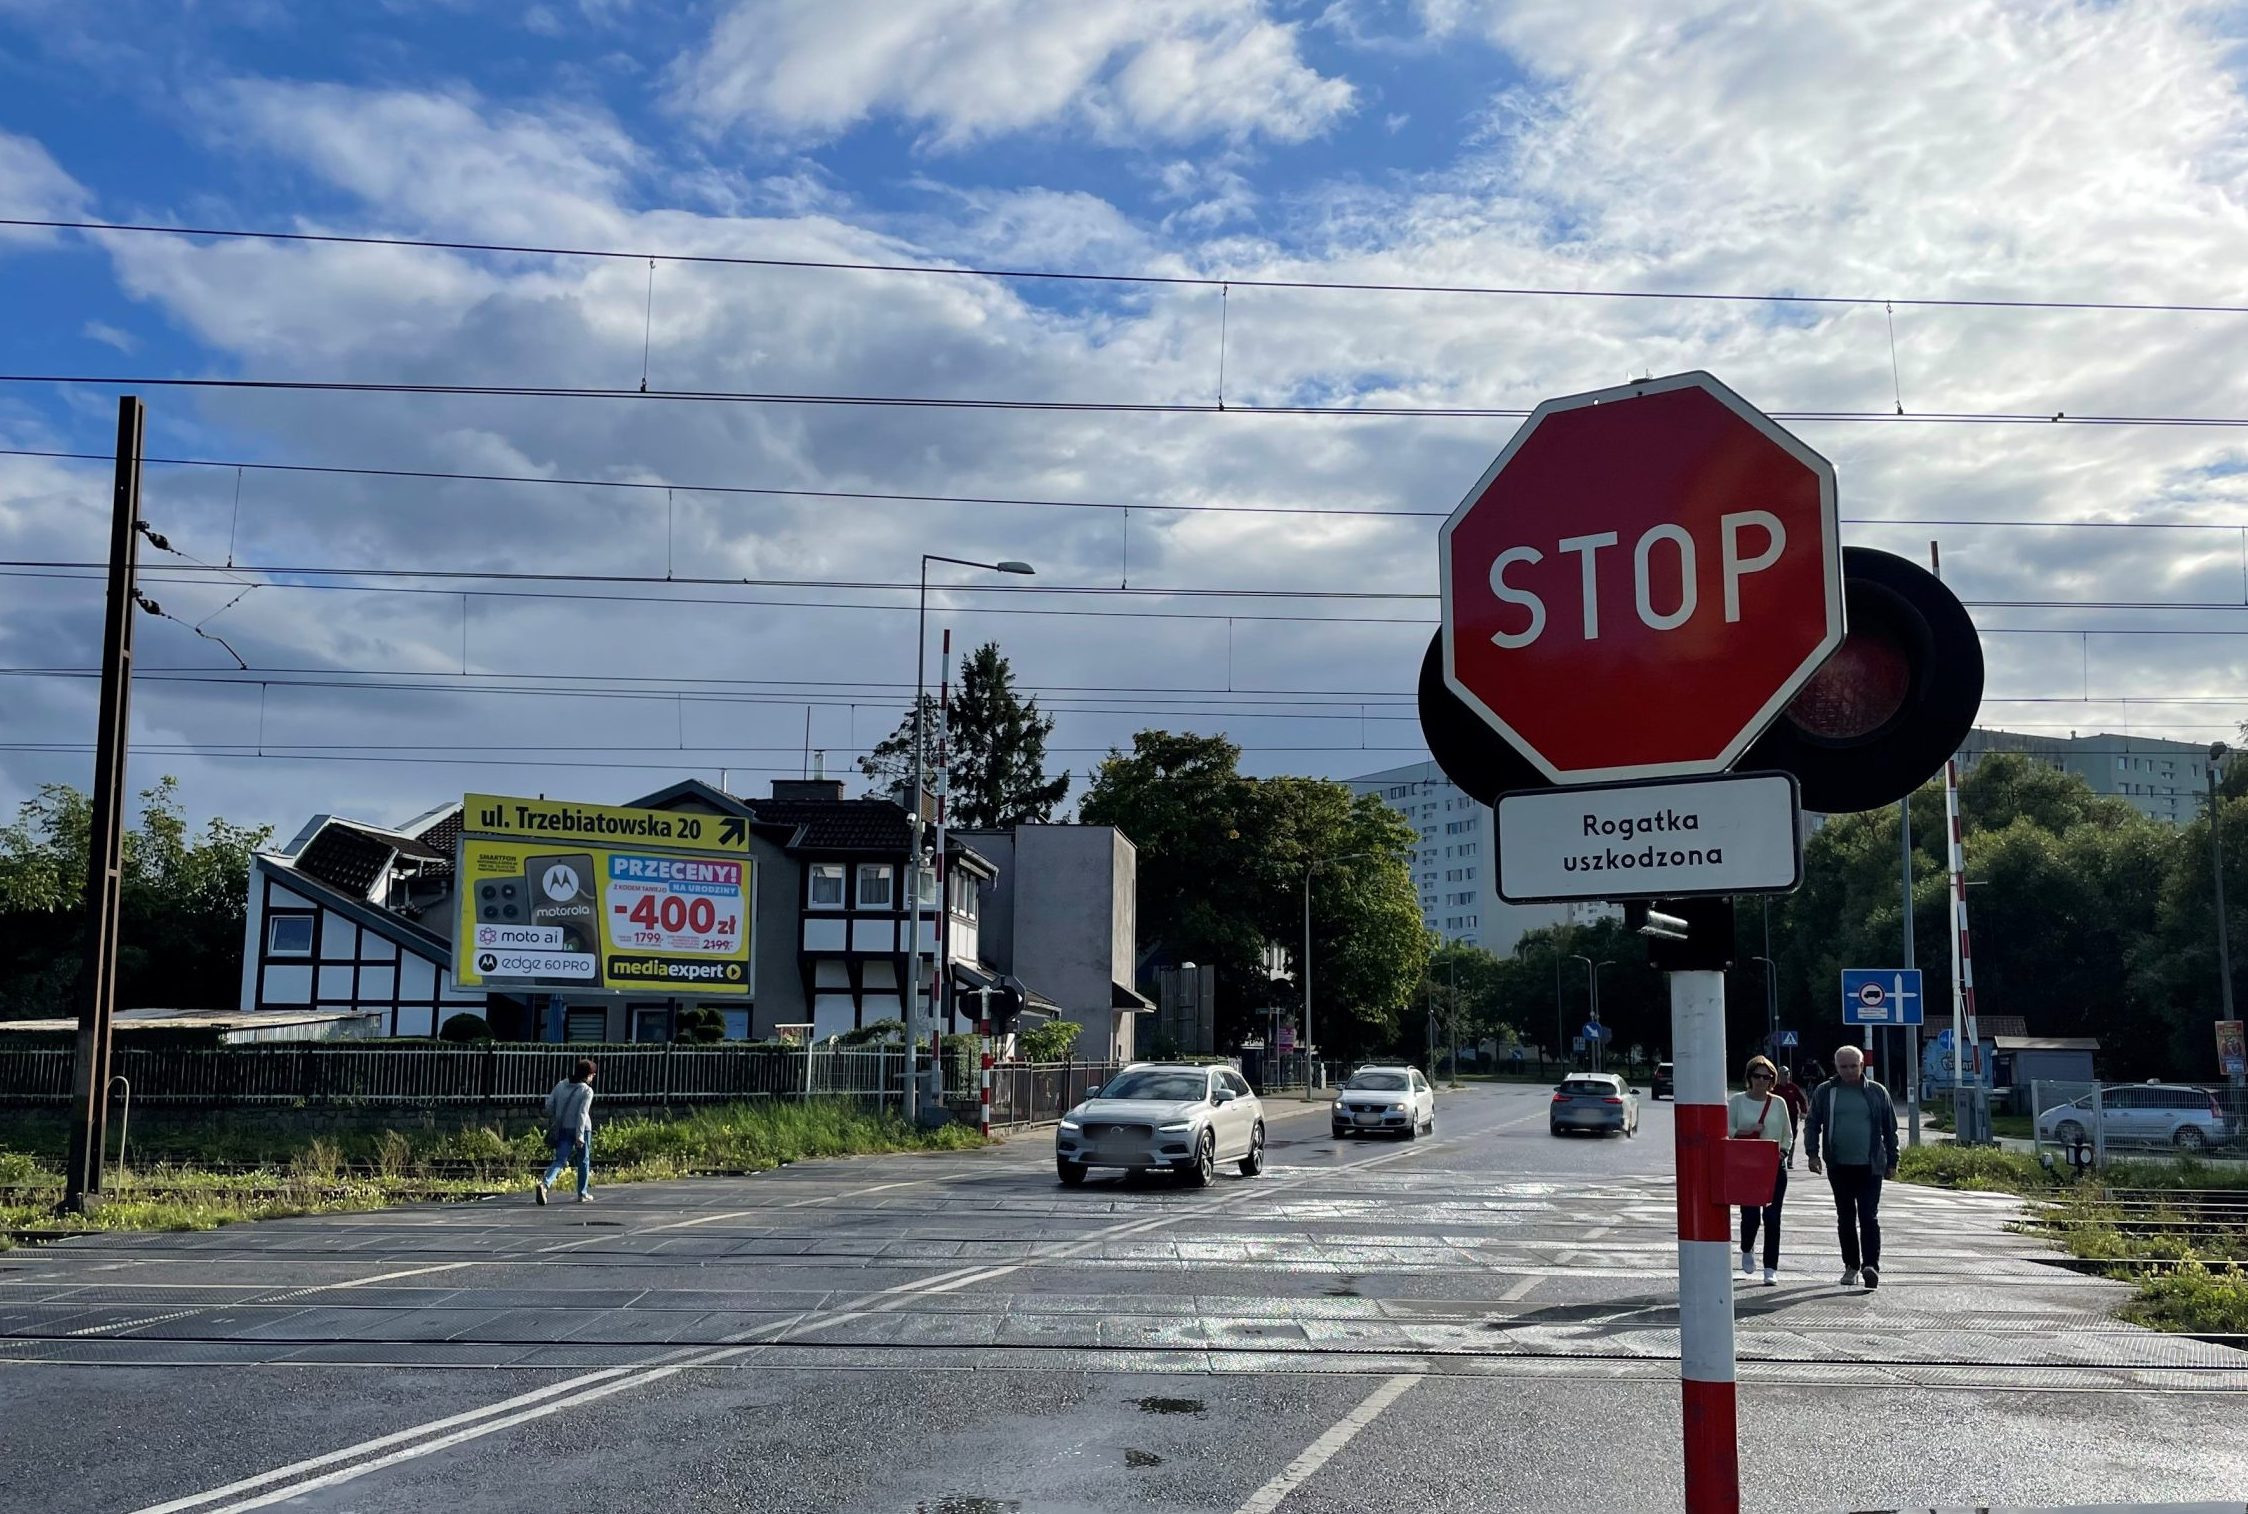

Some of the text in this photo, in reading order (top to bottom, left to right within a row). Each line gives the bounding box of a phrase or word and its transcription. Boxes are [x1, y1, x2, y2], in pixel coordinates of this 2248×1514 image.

[1489, 509, 1787, 649] STOP
[481, 805, 701, 839] ul. Trzebiatowska 20
[1583, 809, 1699, 841] Rogatka
[479, 854, 516, 862] SMARTFON
[1564, 846, 1723, 871] uszkodzona
[614, 858, 737, 882] PRZECENY!
[672, 884, 737, 896] NA URODZINY
[536, 905, 590, 917] motorola
[614, 895, 737, 935] -400 zł
[501, 930, 558, 944] moto ai
[501, 955, 590, 973] edge 60 PRO
[613, 960, 724, 979] mediaexpert
